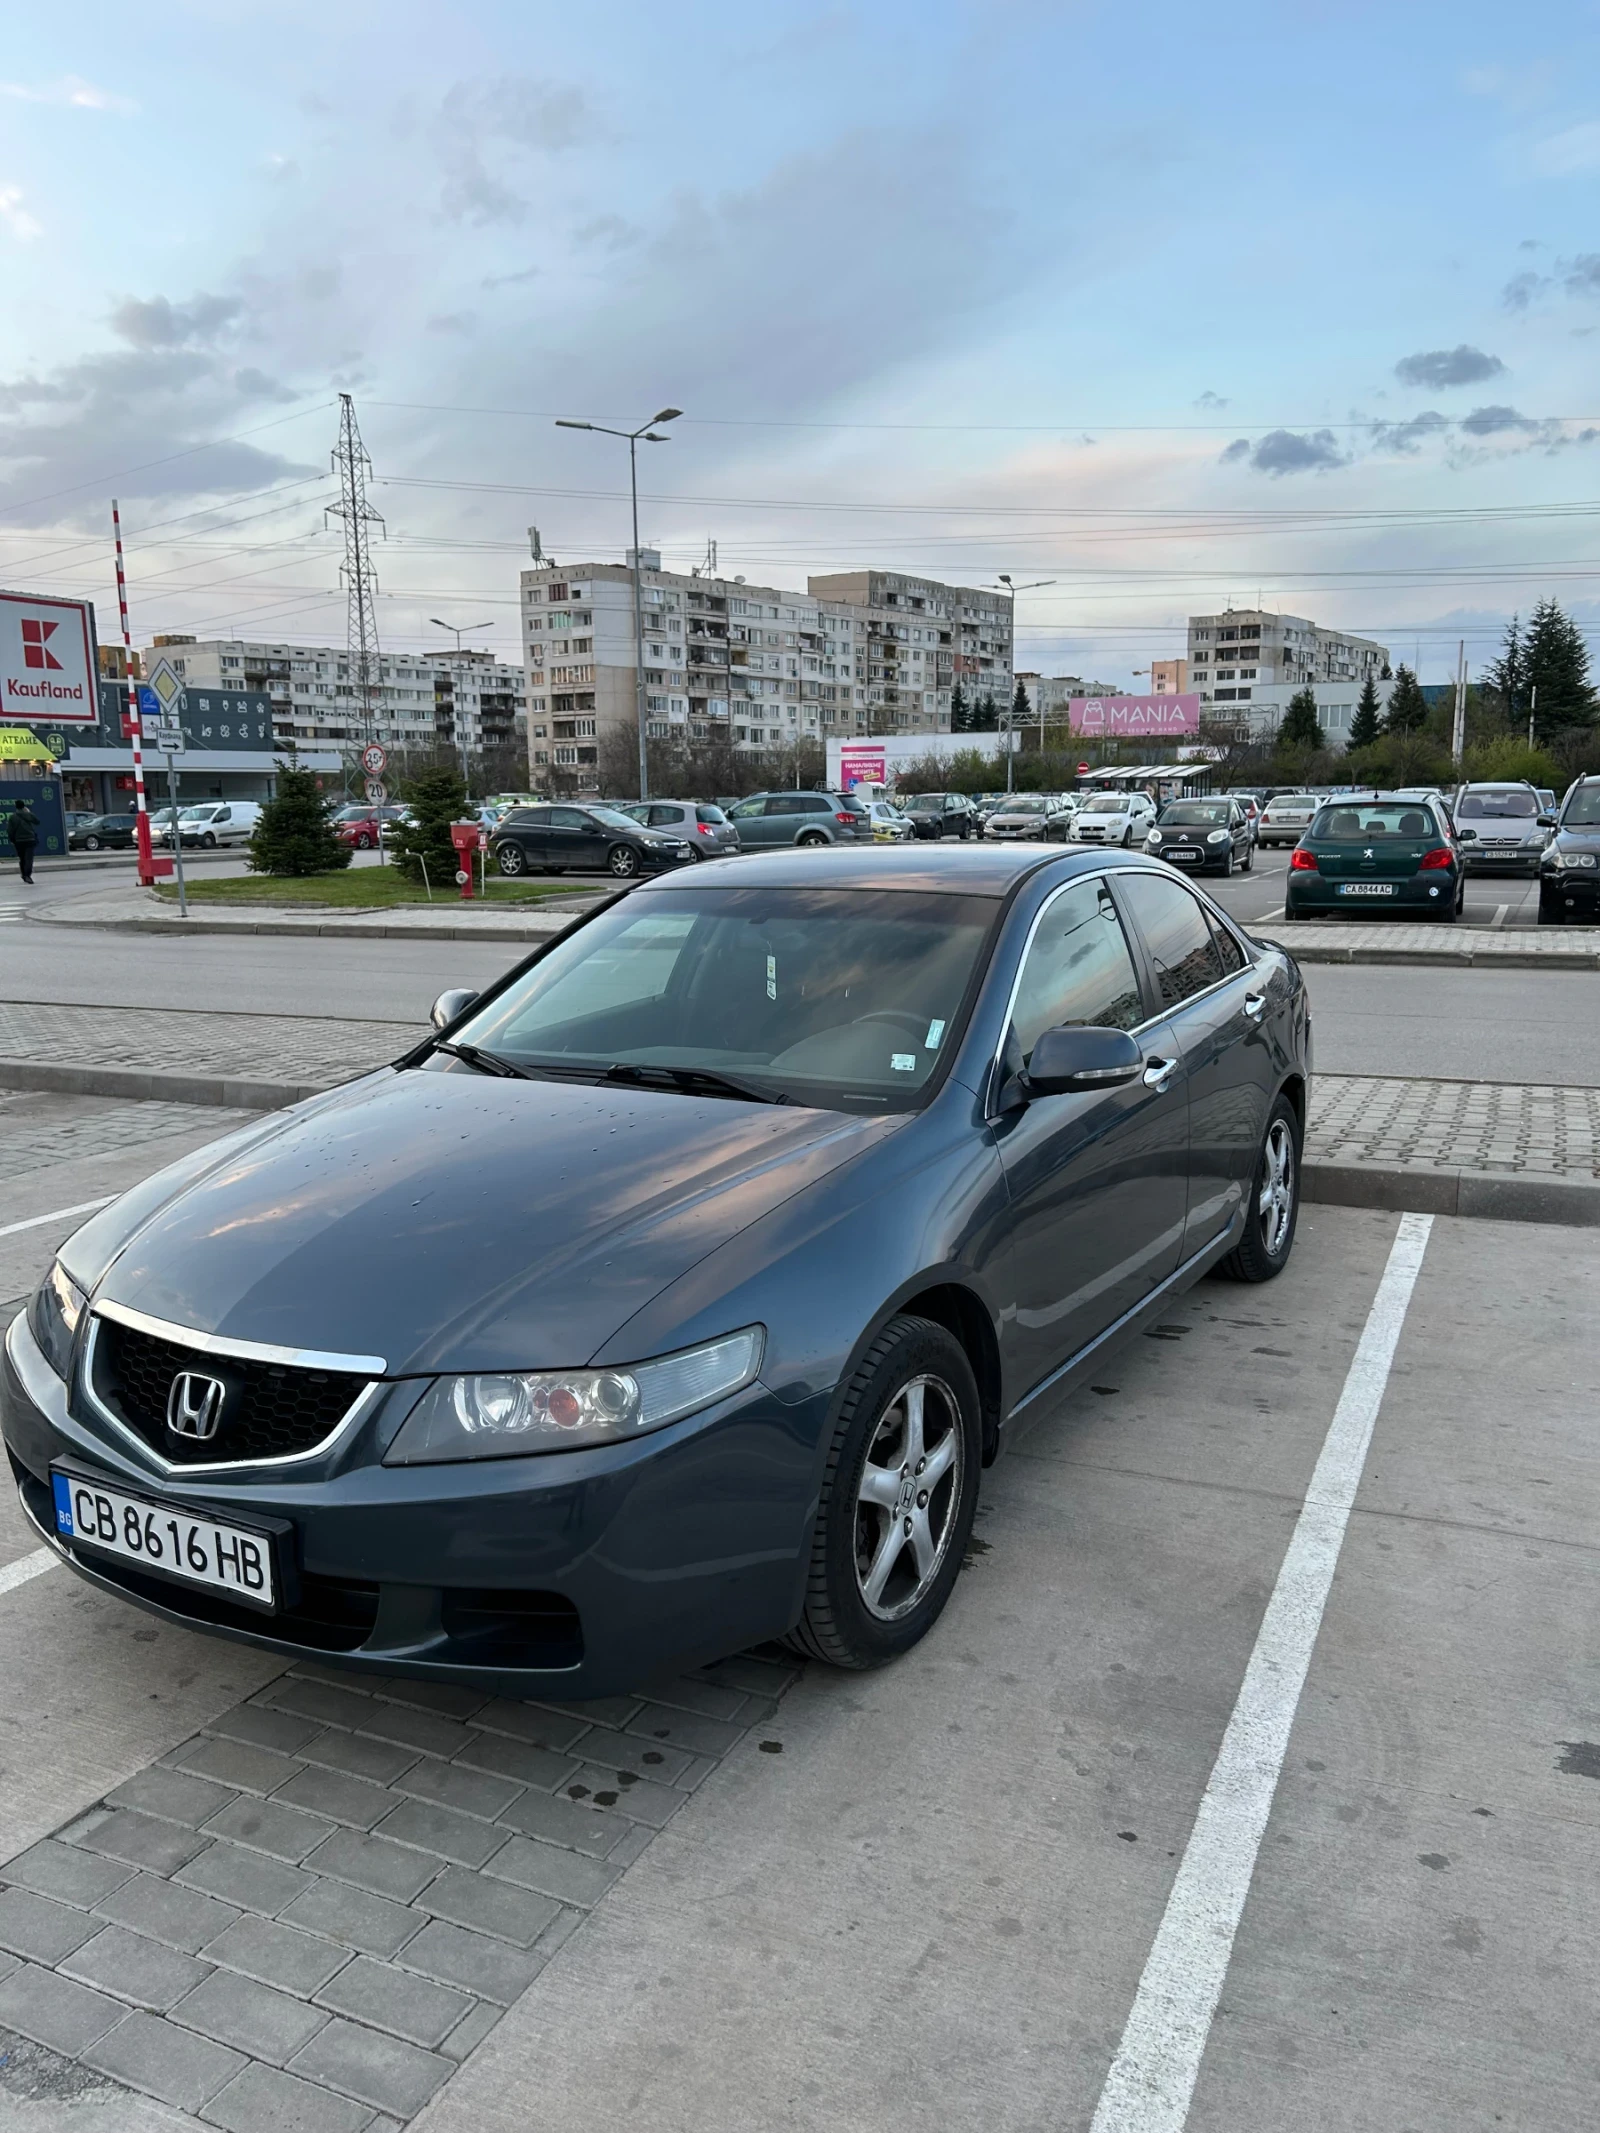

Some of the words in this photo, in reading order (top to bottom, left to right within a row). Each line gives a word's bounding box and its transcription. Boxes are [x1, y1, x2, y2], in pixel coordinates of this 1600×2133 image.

[7, 678, 83, 699] Kaufland
[1110, 704, 1185, 723] MANIA
[369, 783, 383, 797] 20
[1345, 885, 1356, 893] CA
[1357, 885, 1379, 893] 8844
[1380, 885, 1391, 893] AC
[58, 1510, 72, 1526] BG
[75, 1489, 117, 1543] CB
[123, 1505, 208, 1573] 8616
[214, 1531, 264, 1590] HB
